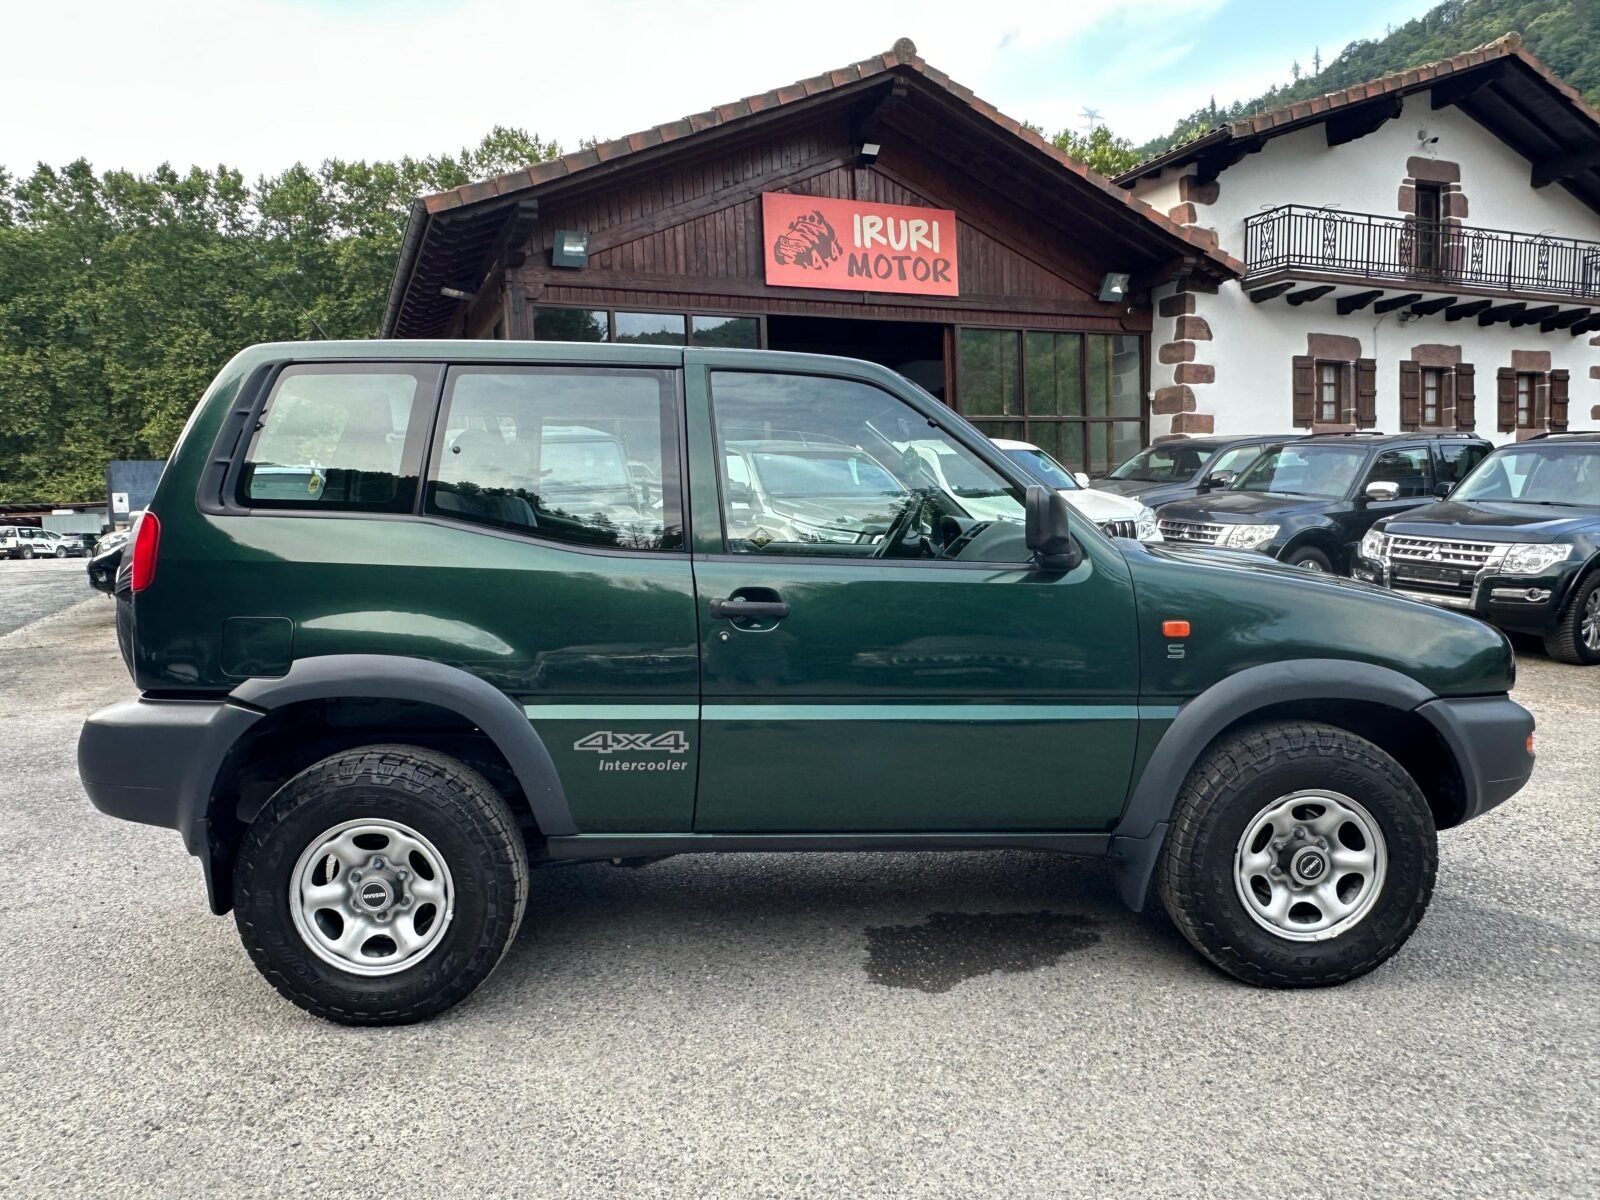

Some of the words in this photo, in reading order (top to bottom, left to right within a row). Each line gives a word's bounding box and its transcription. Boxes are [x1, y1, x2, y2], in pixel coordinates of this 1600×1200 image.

[853, 213, 939, 253] IRURI
[847, 253, 952, 283] MOTOR
[1167, 643, 1185, 659] S
[598, 759, 688, 771] Intercooler
